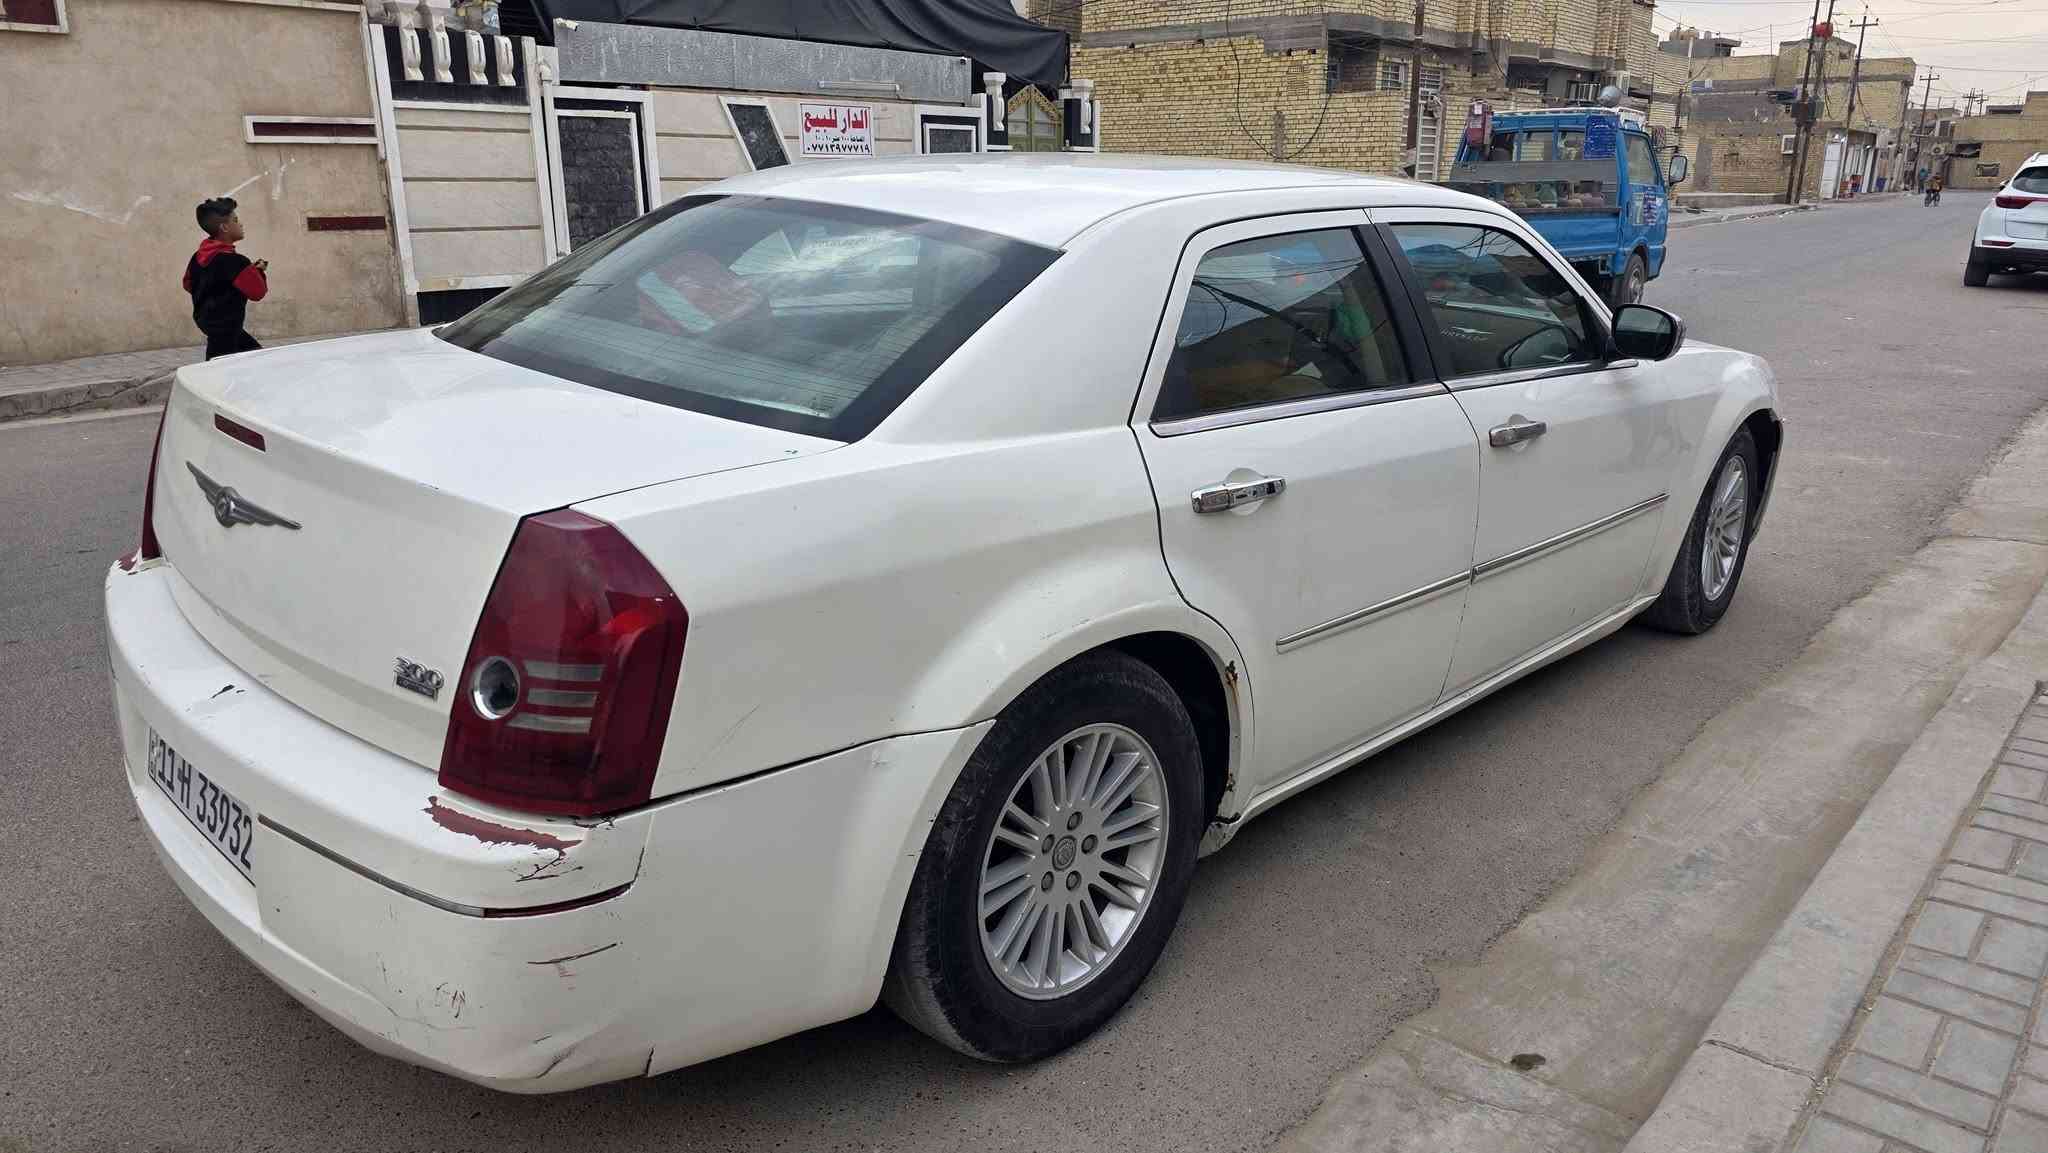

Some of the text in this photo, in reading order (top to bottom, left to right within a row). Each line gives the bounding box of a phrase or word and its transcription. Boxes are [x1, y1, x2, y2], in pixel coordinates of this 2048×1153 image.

[804, 106, 868, 134] الدار للبيع
[392, 656, 445, 689] 300
[158, 739, 175, 792] 11
[177, 759, 192, 809] H
[196, 772, 252, 870] 33932
